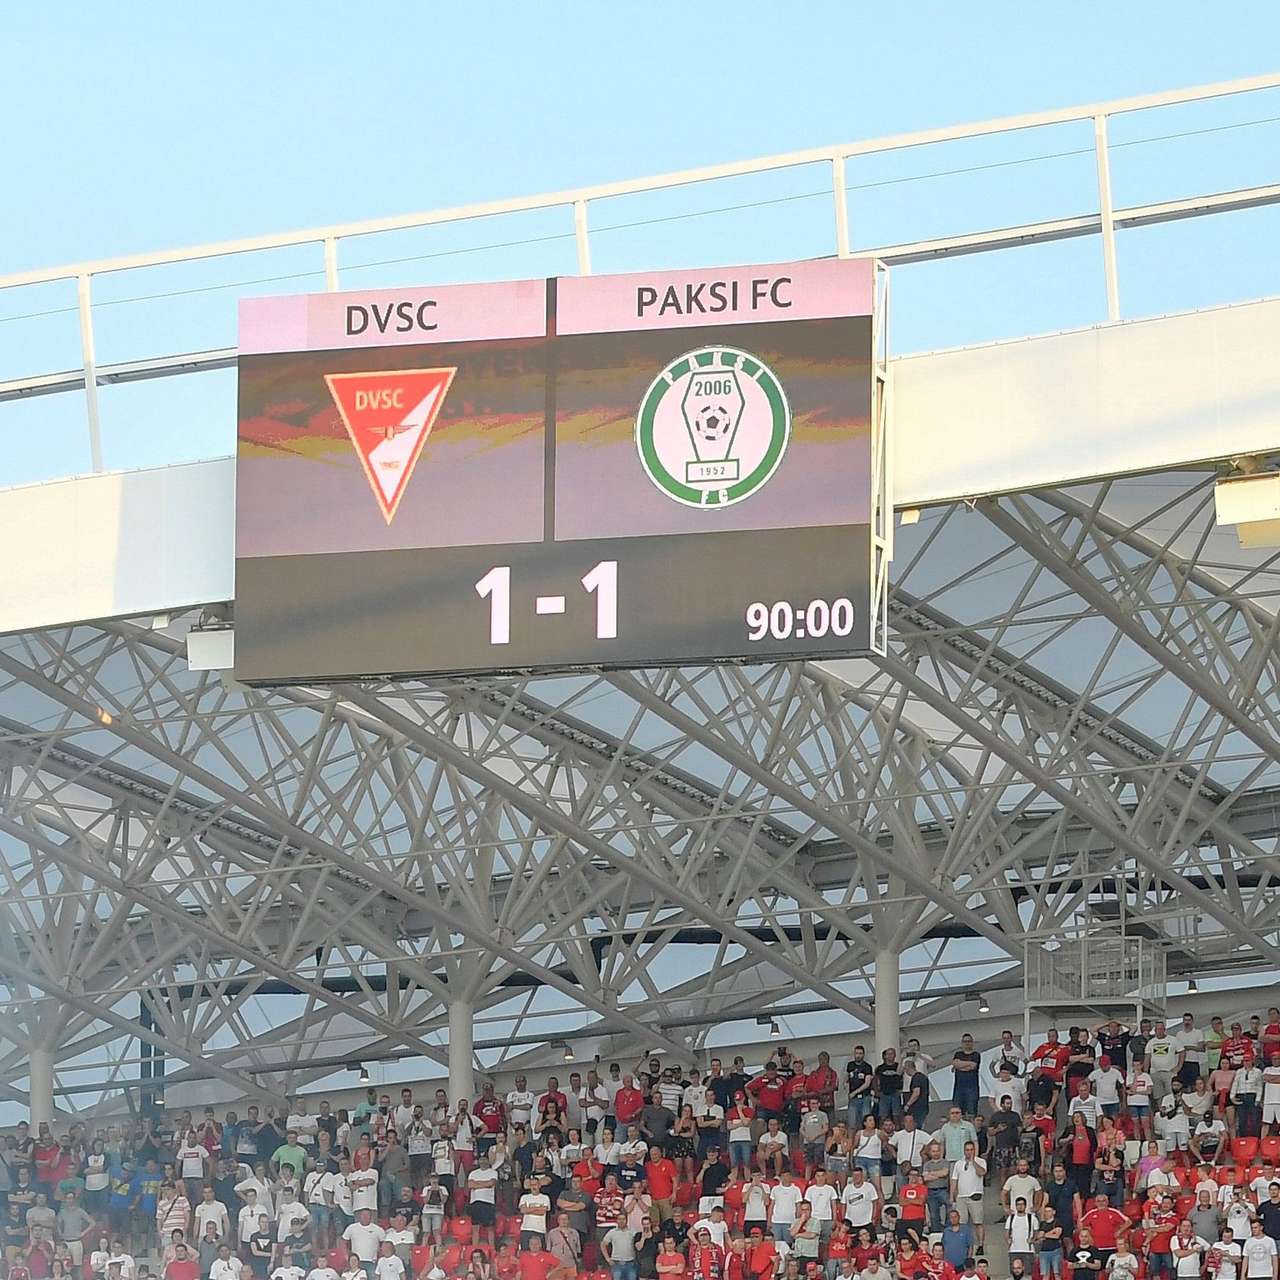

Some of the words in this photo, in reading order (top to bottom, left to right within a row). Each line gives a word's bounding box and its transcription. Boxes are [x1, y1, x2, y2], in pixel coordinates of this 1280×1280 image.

[637, 281, 738, 317] PAKSI
[752, 277, 792, 310] FC
[346, 300, 438, 335] DVSC
[355, 388, 404, 411] DVSC
[695, 380, 732, 397] 2006
[700, 467, 726, 476] 1952
[475, 566, 510, 645] 1
[581, 560, 618, 640] 1
[746, 598, 854, 641] 90:00
